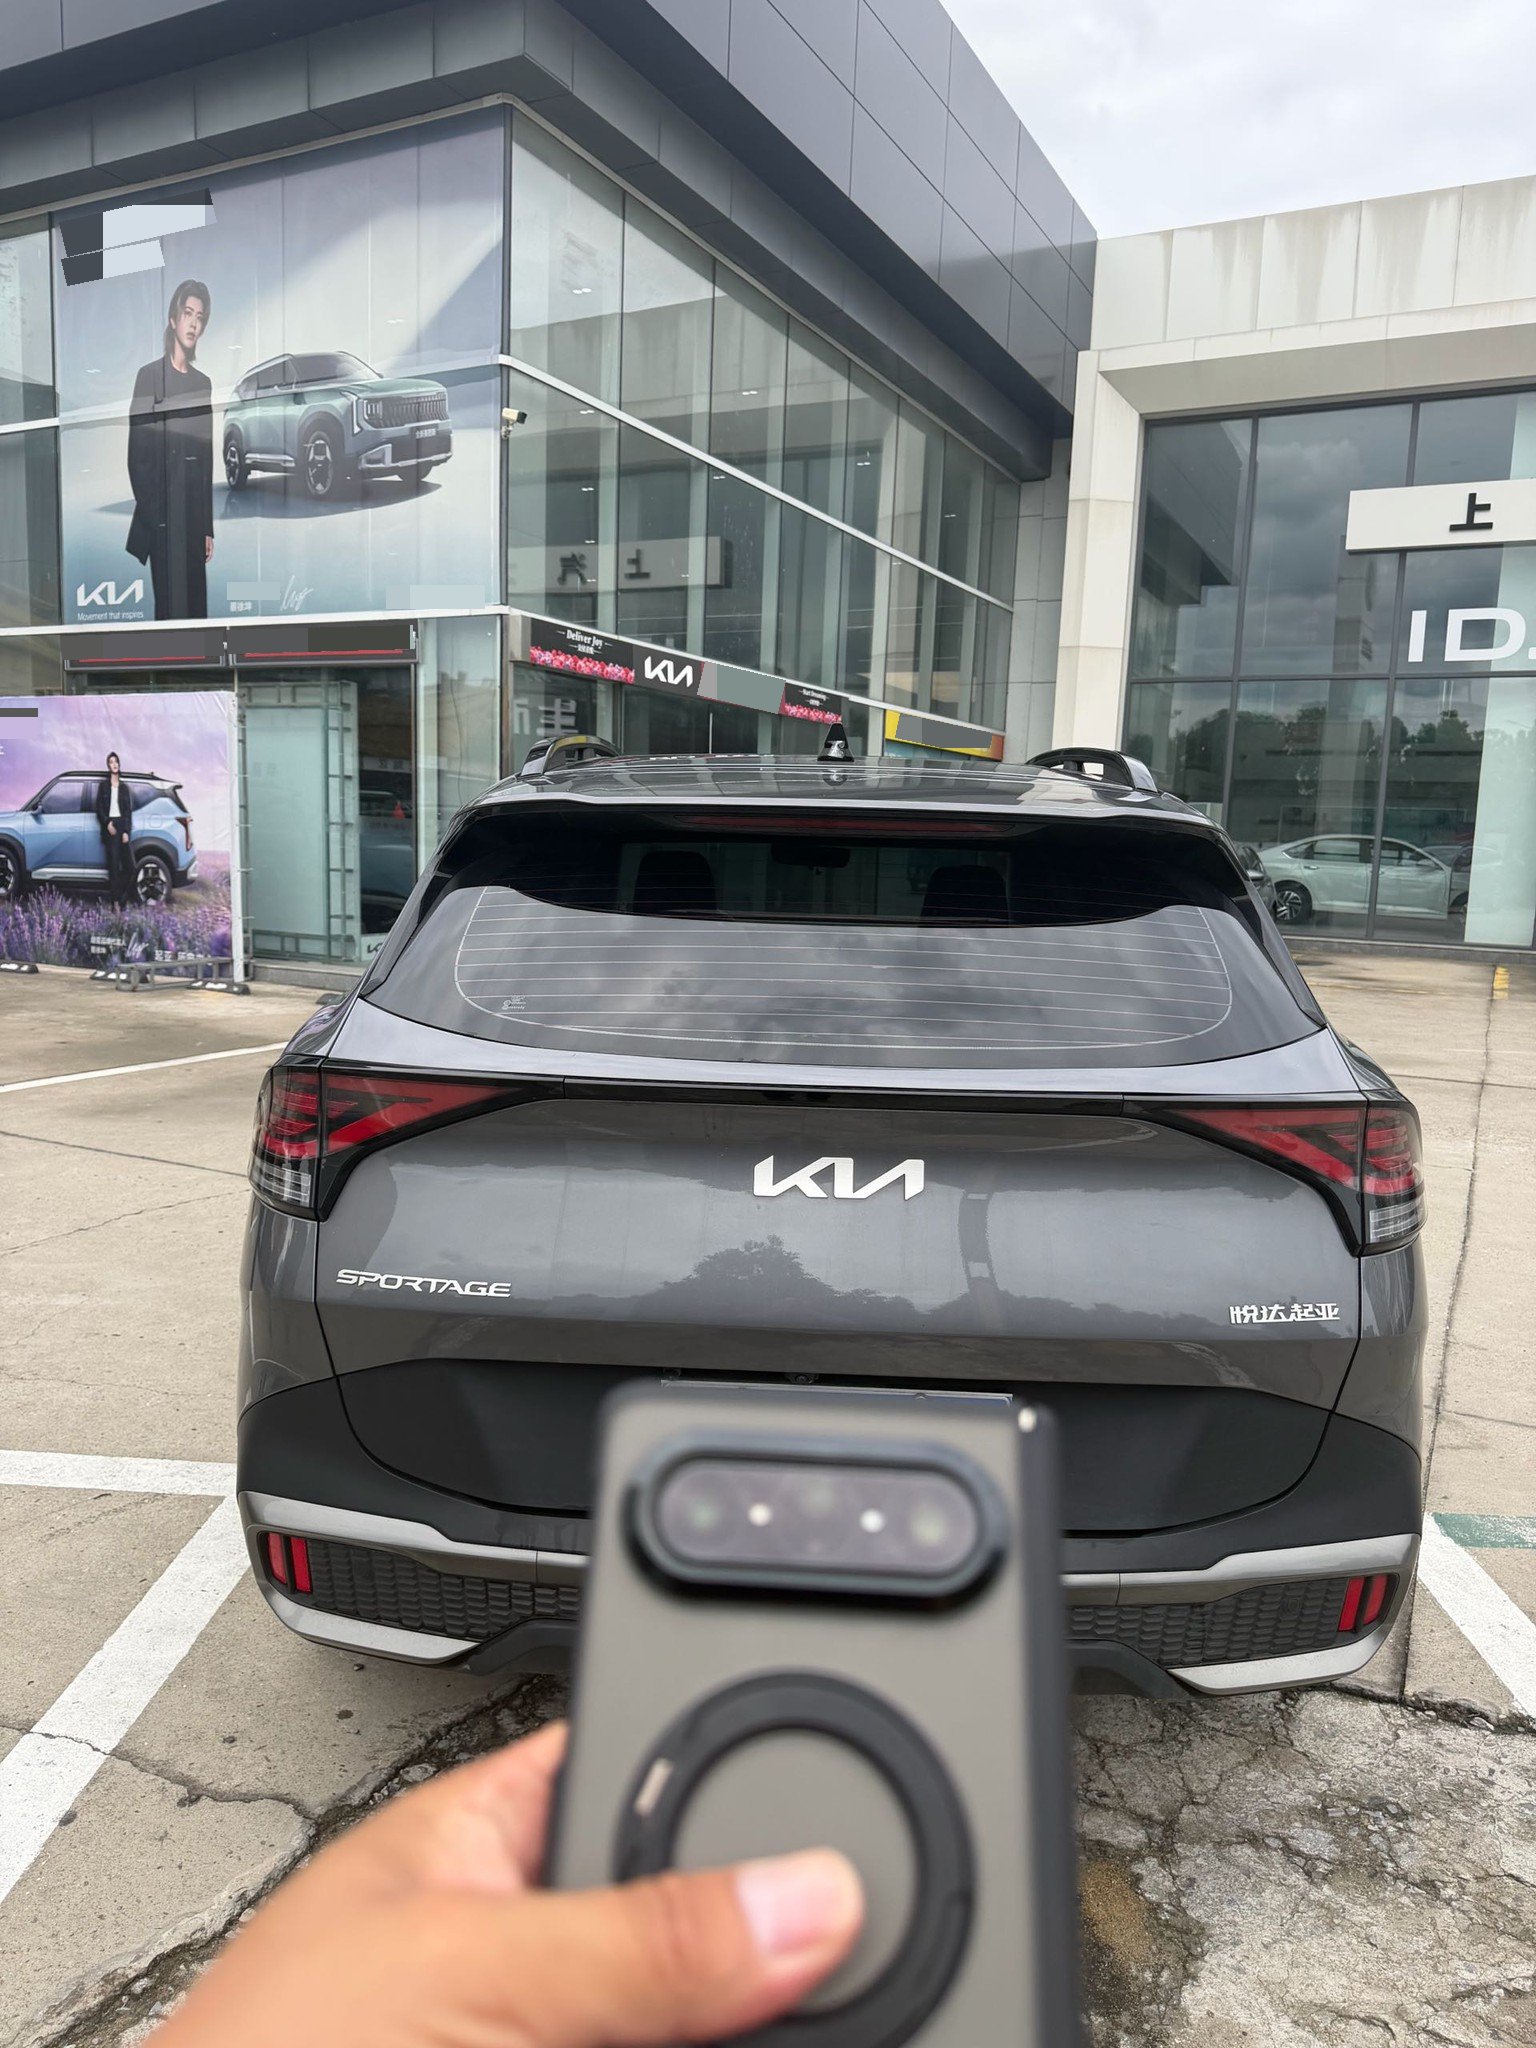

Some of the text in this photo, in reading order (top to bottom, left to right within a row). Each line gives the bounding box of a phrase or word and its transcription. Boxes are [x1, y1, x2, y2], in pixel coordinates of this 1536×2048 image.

[1449, 492, 1493, 532] 上
[76, 579, 143, 607] KIA
[77, 612, 107, 621] Movement
[566, 629, 592, 645] Deliver
[592, 637, 603, 649] Joy
[644, 656, 694, 688] KIA
[753, 1155, 925, 1201] KIA
[336, 1268, 512, 1298] SPORTAGE
[1229, 1302, 1341, 1325] 悦达起亚
